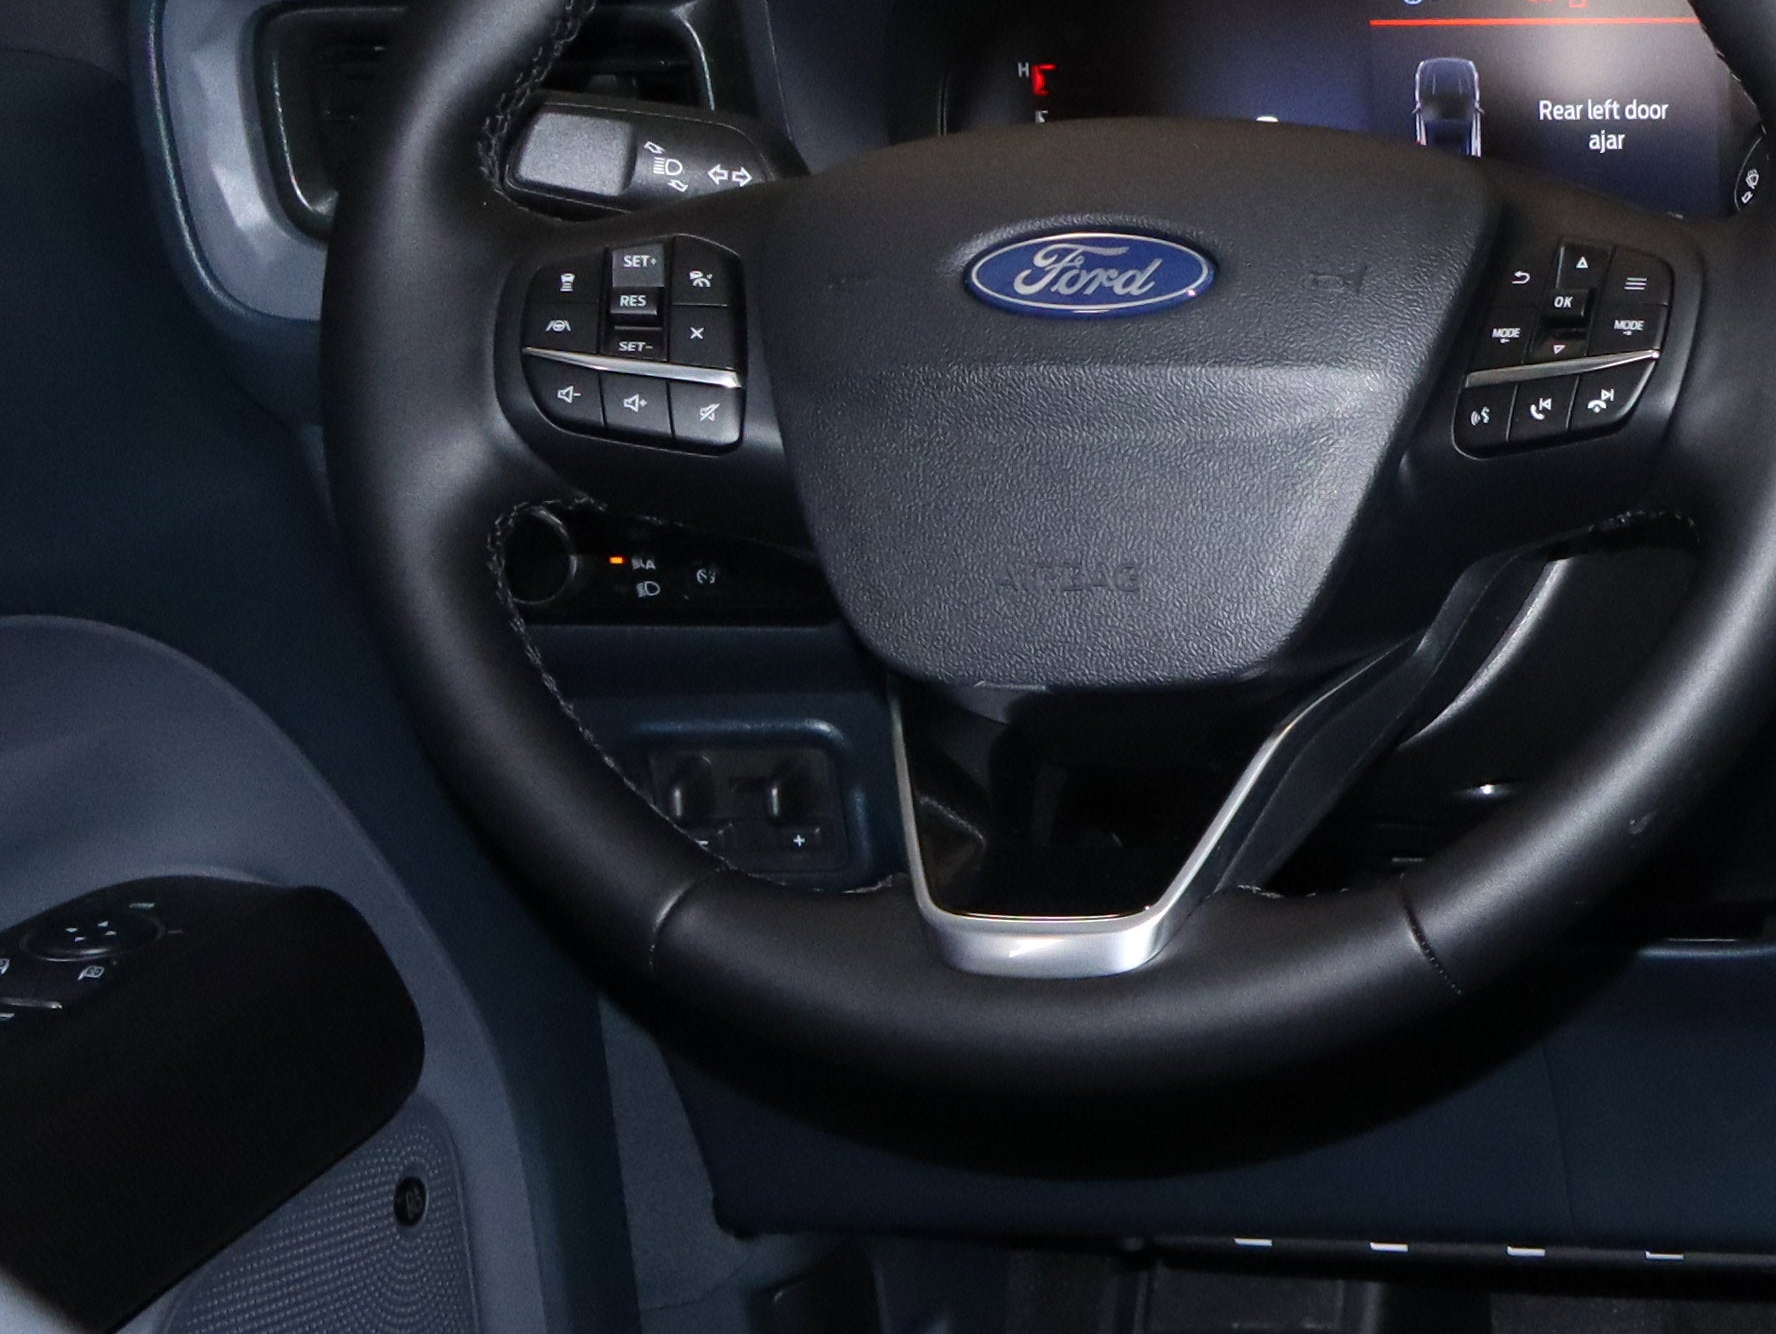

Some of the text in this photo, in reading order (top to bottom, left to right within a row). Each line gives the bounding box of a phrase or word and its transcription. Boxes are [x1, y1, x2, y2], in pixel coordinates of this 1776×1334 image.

[1017, 62, 1030, 78] H
[1539, 99, 1669, 121] Rear left door
[1588, 130, 1626, 153] ajar
[1013, 243, 1158, 298] Ford
[620, 294, 647, 308] RES
[1554, 296, 1573, 309] OK
[1492, 327, 1520, 339] MODE
[1614, 319, 1644, 332] MODE
